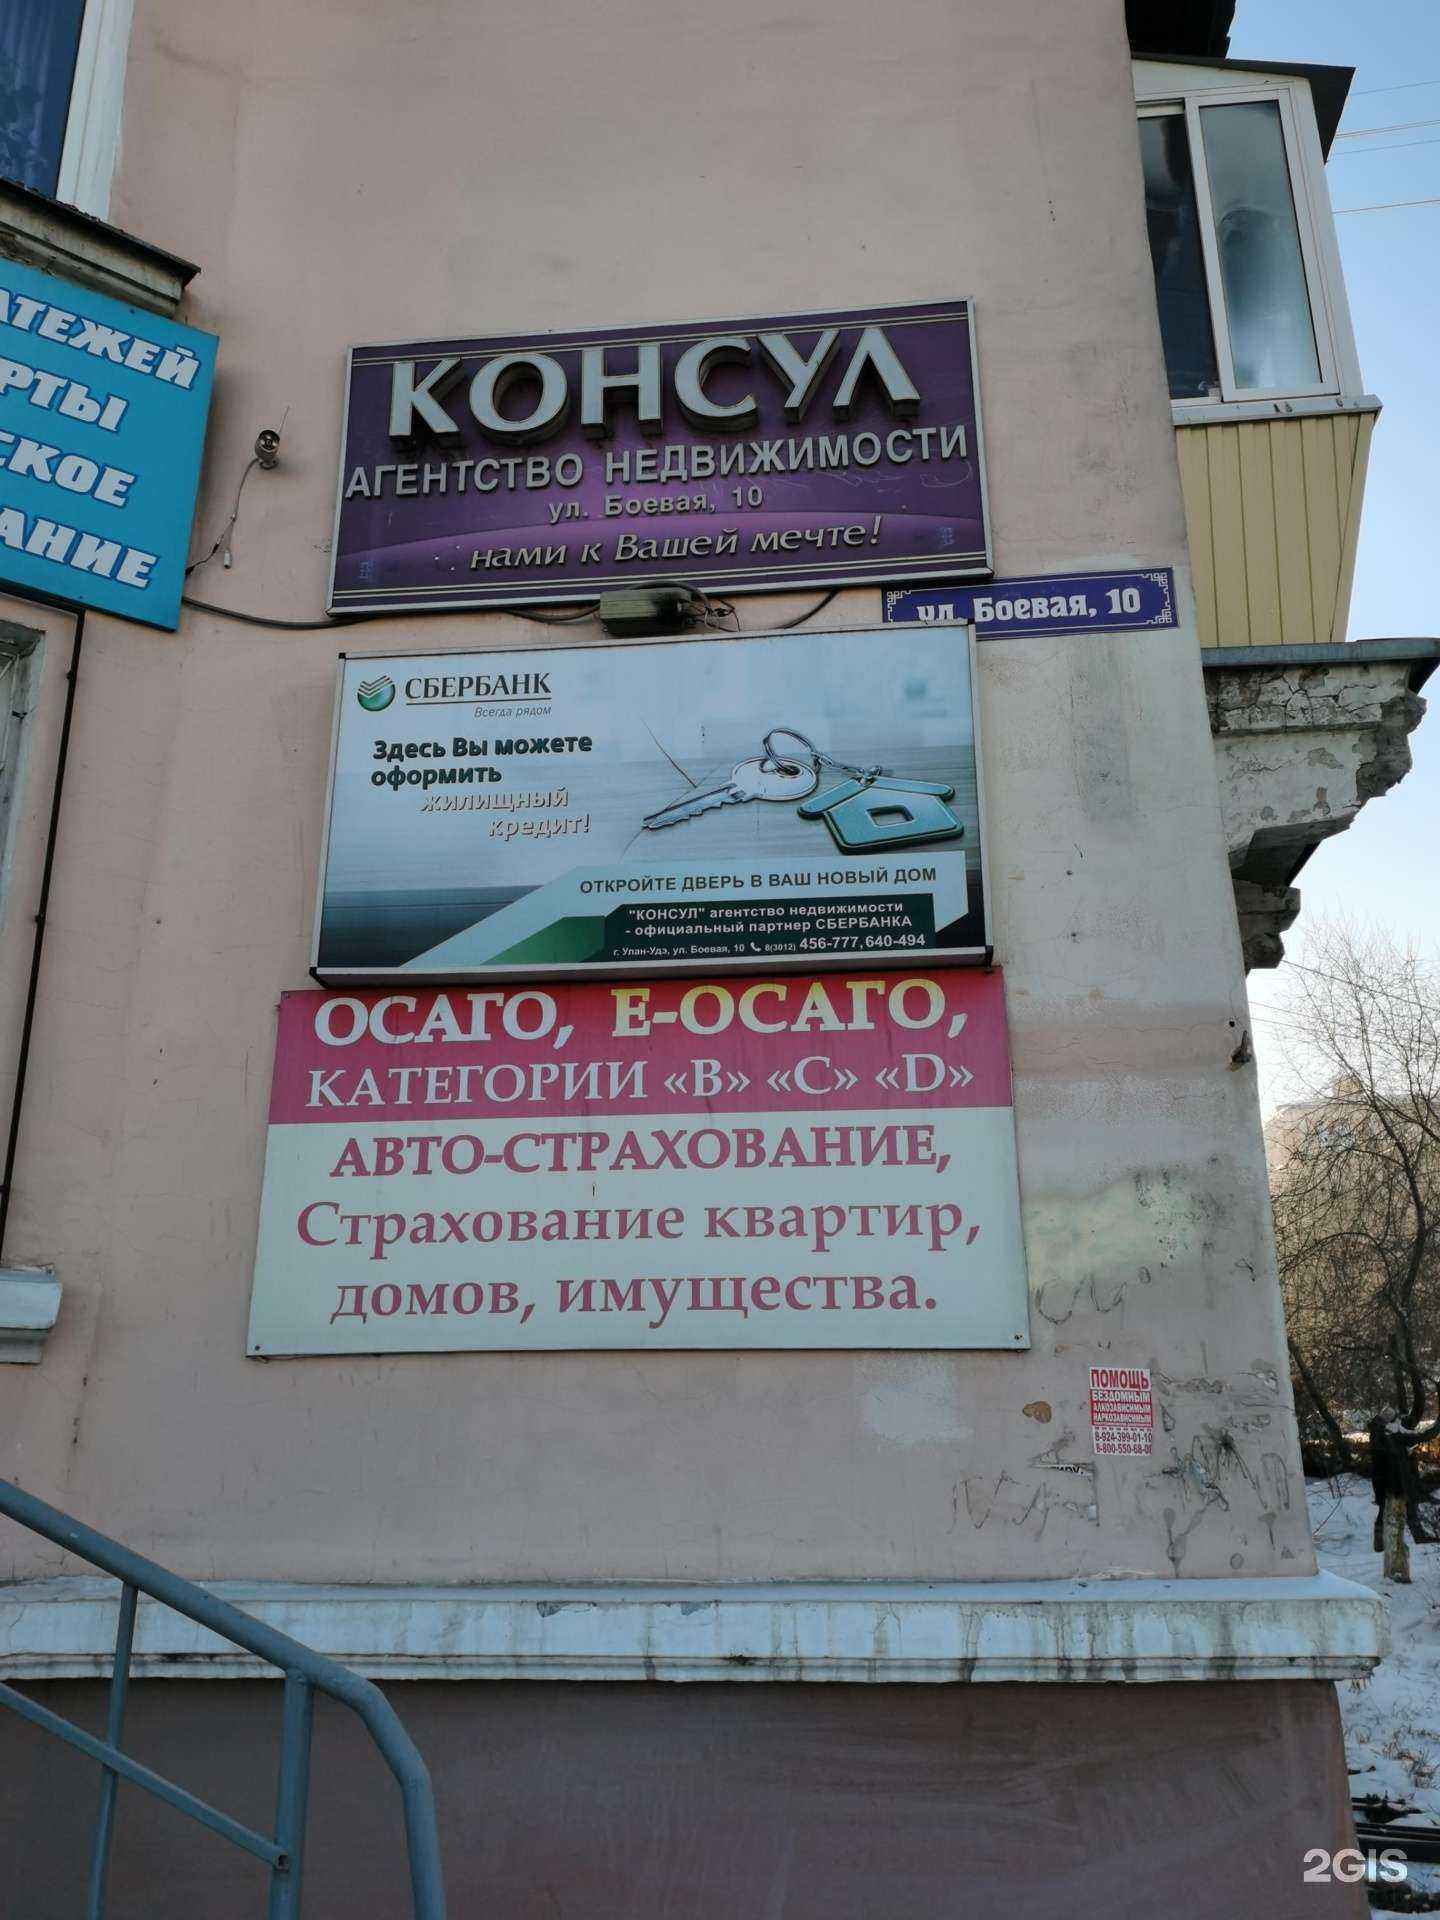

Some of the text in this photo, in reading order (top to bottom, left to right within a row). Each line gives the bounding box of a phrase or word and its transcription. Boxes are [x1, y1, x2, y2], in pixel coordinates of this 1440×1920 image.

[388, 326, 921, 440] КОНСУЛ
[0, 431, 135, 507] КОЕ
[345, 424, 968, 499] АГЕНТСТВО НЕДВИЖИМОСТИ
[549, 486, 763, 525] ул. Боевая, 10
[470, 514, 884, 571] нами к Вашей мечте!
[973, 593, 1097, 623] Боевая,
[1106, 587, 1141, 614] 10
[405, 672, 552, 700] СБЕРБАНК
[474, 705, 552, 719] Всегда рядом
[373, 734, 593, 763] Здесь Вы можете
[371, 765, 502, 791] оформить
[420, 786, 569, 814] жилищный
[488, 813, 592, 842] кредит!
[580, 866, 937, 894] ОТКРОЙТЕ ДВЕРЬ В ВАШ НОВЫЙ ДОМ
[629, 902, 904, 921] "КОНСУЛ" агентство недвижимости
[635, 921, 744, 938] официальный
[749, 919, 812, 934] партнер
[815, 915, 913, 930] СБЕРБАНКА
[734, 943, 745, 952] 10
[765, 942, 797, 953] 8(3012)
[314, 978, 969, 1050] ОСАГО, Е-ОСАГО,
[305, 1060, 648, 1109] КАТЕГОРИИ
[875, 1052, 974, 1093] «D»
[329, 1124, 952, 1179] АВТО-СТРАХОВАНИЕ,
[296, 1201, 982, 1261] Страхование квартир,
[330, 1275, 938, 1329] домов, имущества.
[1091, 1369, 1150, 1390] ПОМОЩЬ
[1092, 1390, 1151, 1402] БЕЗДОМНЫМ
